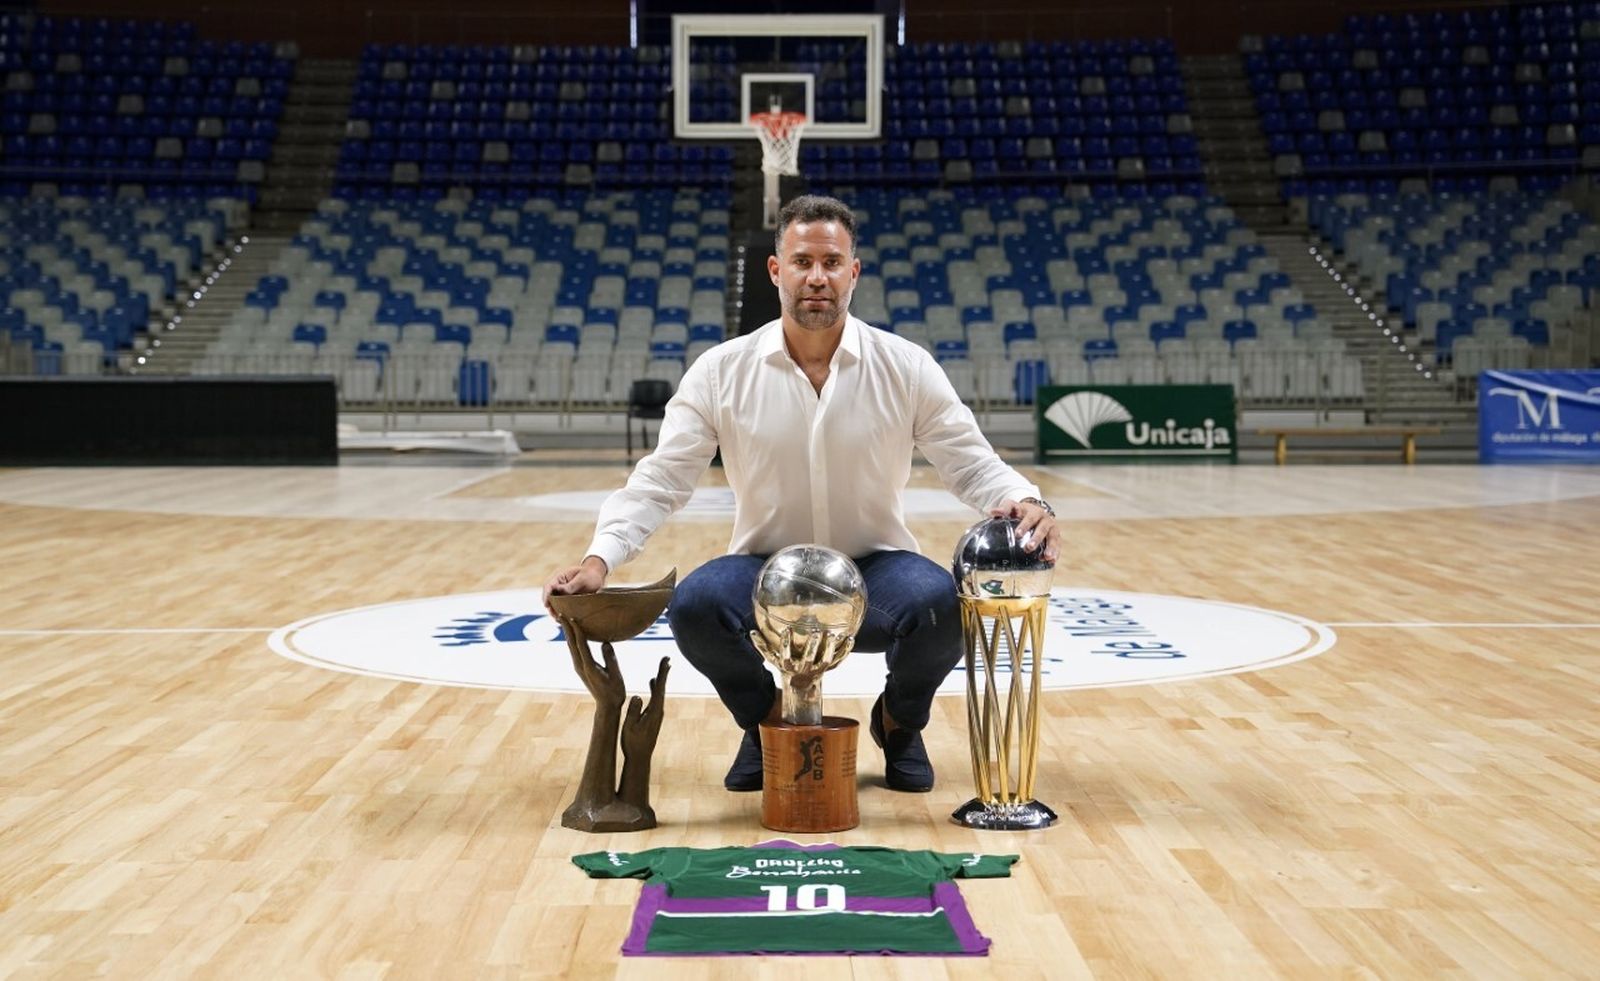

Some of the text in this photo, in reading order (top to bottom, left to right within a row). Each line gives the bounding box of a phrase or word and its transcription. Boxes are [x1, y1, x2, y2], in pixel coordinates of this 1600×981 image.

[1488, 387, 1565, 430] M
[1125, 418, 1231, 449] Unicaja
[1539, 432, 1550, 442] de
[1048, 597, 1157, 637] Málaga
[1090, 641, 1187, 659] de
[812, 743, 824, 781] ACB
[760, 884, 846, 912] 10
